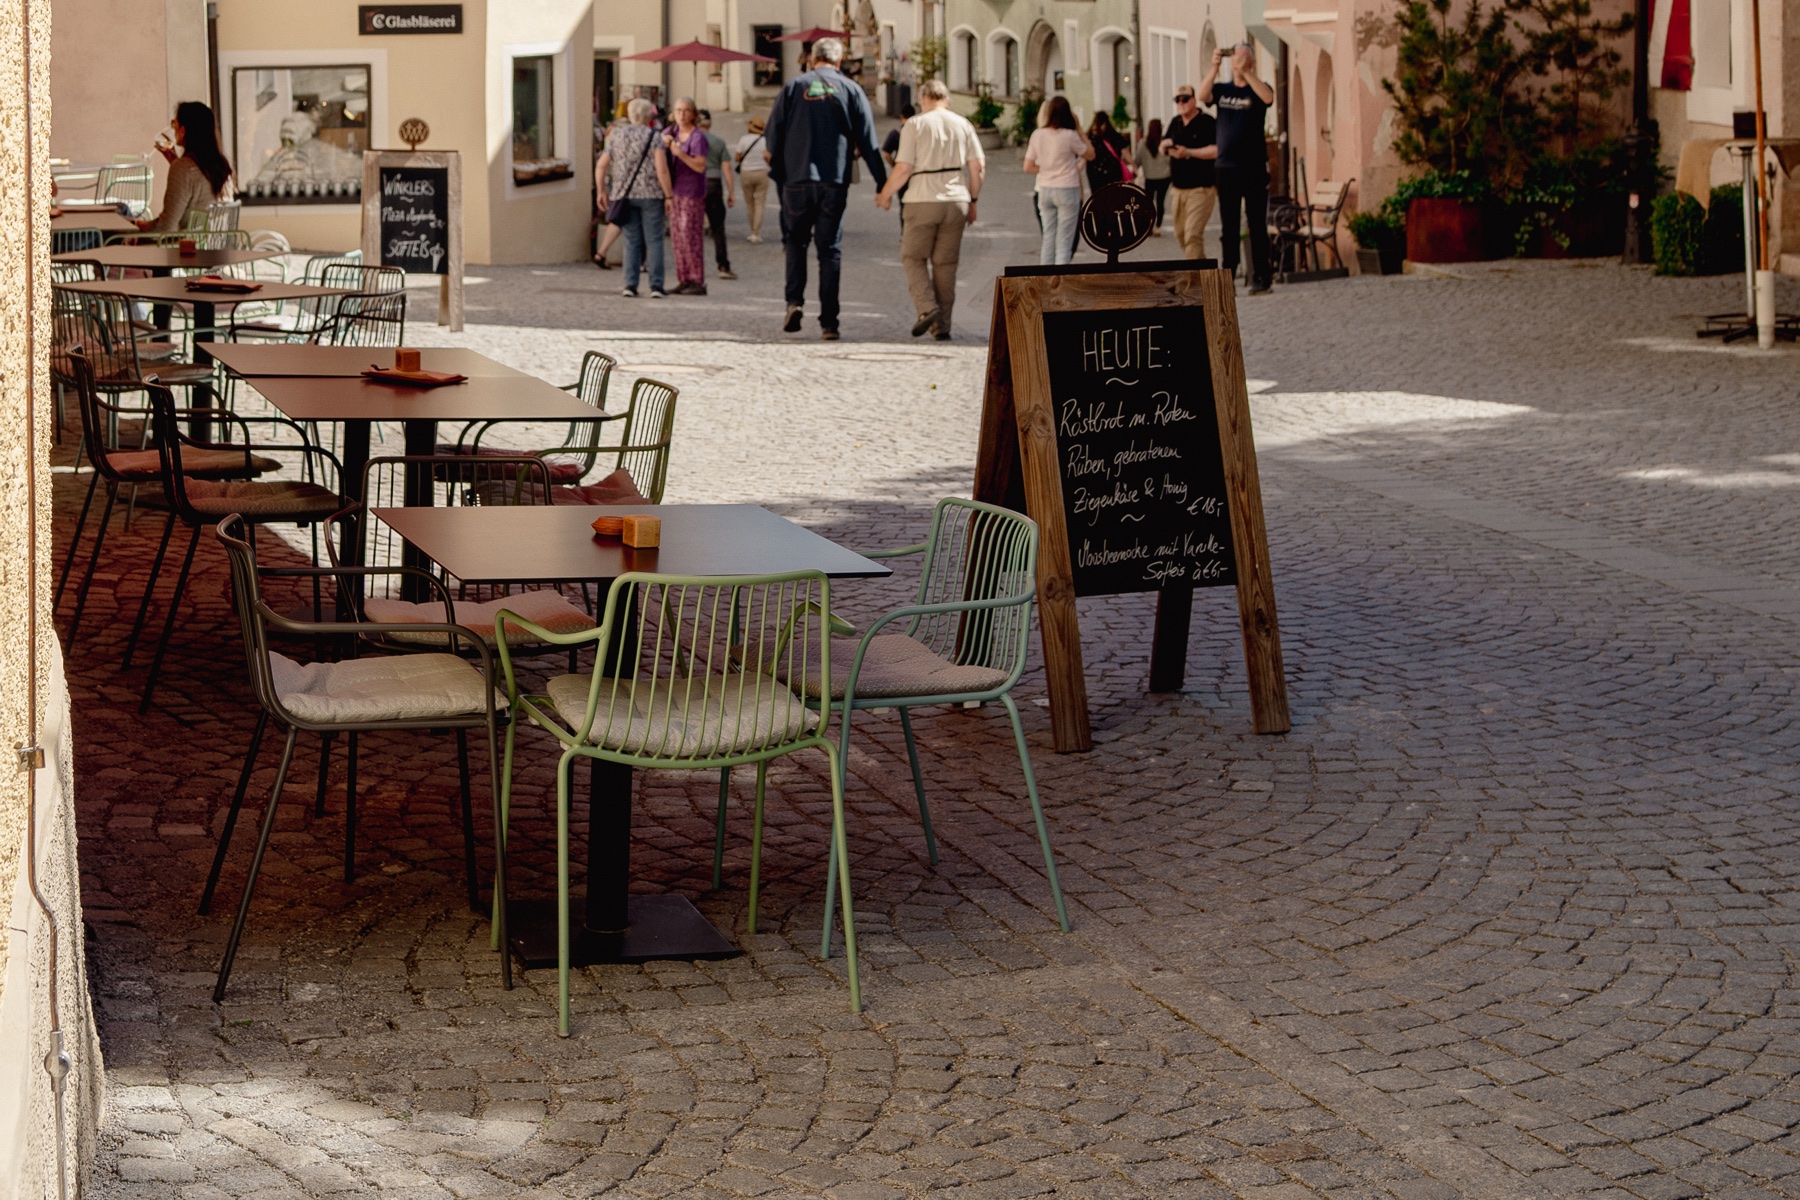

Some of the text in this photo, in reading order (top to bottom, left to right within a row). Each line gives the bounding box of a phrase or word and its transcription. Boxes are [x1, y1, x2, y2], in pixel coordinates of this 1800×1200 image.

[385, 14, 456, 29] Glasbläserei
[1082, 325, 1172, 373] HEUTE:
[1059, 390, 1197, 438] Röstbrot m. Roten
[1066, 438, 1182, 481] Rüben, gebratenem
[1073, 471, 1188, 527] Ziegenkäse & Honig
[1154, 535, 1179, 557] mit
[1142, 560, 1186, 587] Softeis
